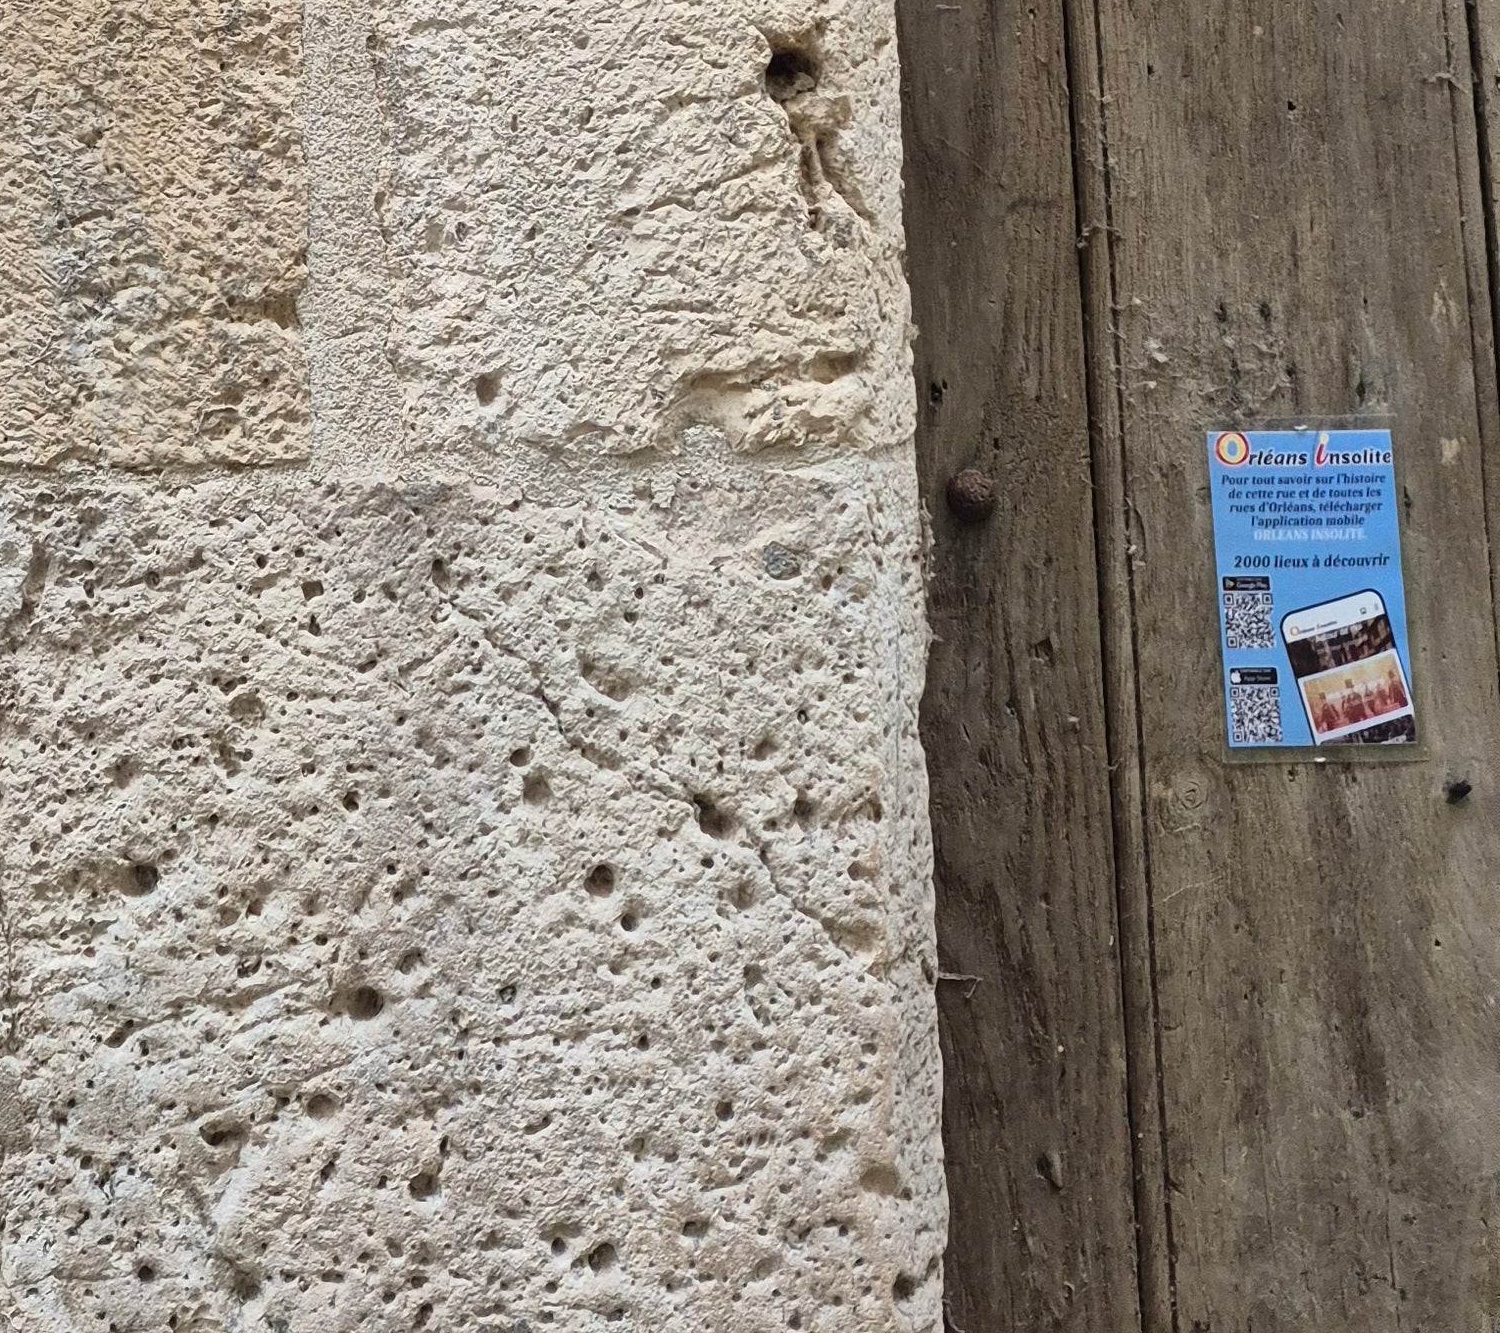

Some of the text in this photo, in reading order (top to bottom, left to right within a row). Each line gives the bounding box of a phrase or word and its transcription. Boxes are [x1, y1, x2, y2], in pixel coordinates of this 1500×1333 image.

[1214, 431, 1308, 467] Orléans
[1221, 474, 1249, 485] Pour
[1251, 475, 1275, 485] tout
[1277, 473, 1313, 485] savoir
[1315, 475, 1335, 484] sur
[1228, 486, 1382, 499] de cette rue et de toutes les
[1229, 504, 1255, 513] rues
[1319, 500, 1383, 514] télécharger
[1325, 514, 1366, 526] mobile
[1234, 552, 1391, 568] 2000 lieux à découvrir
